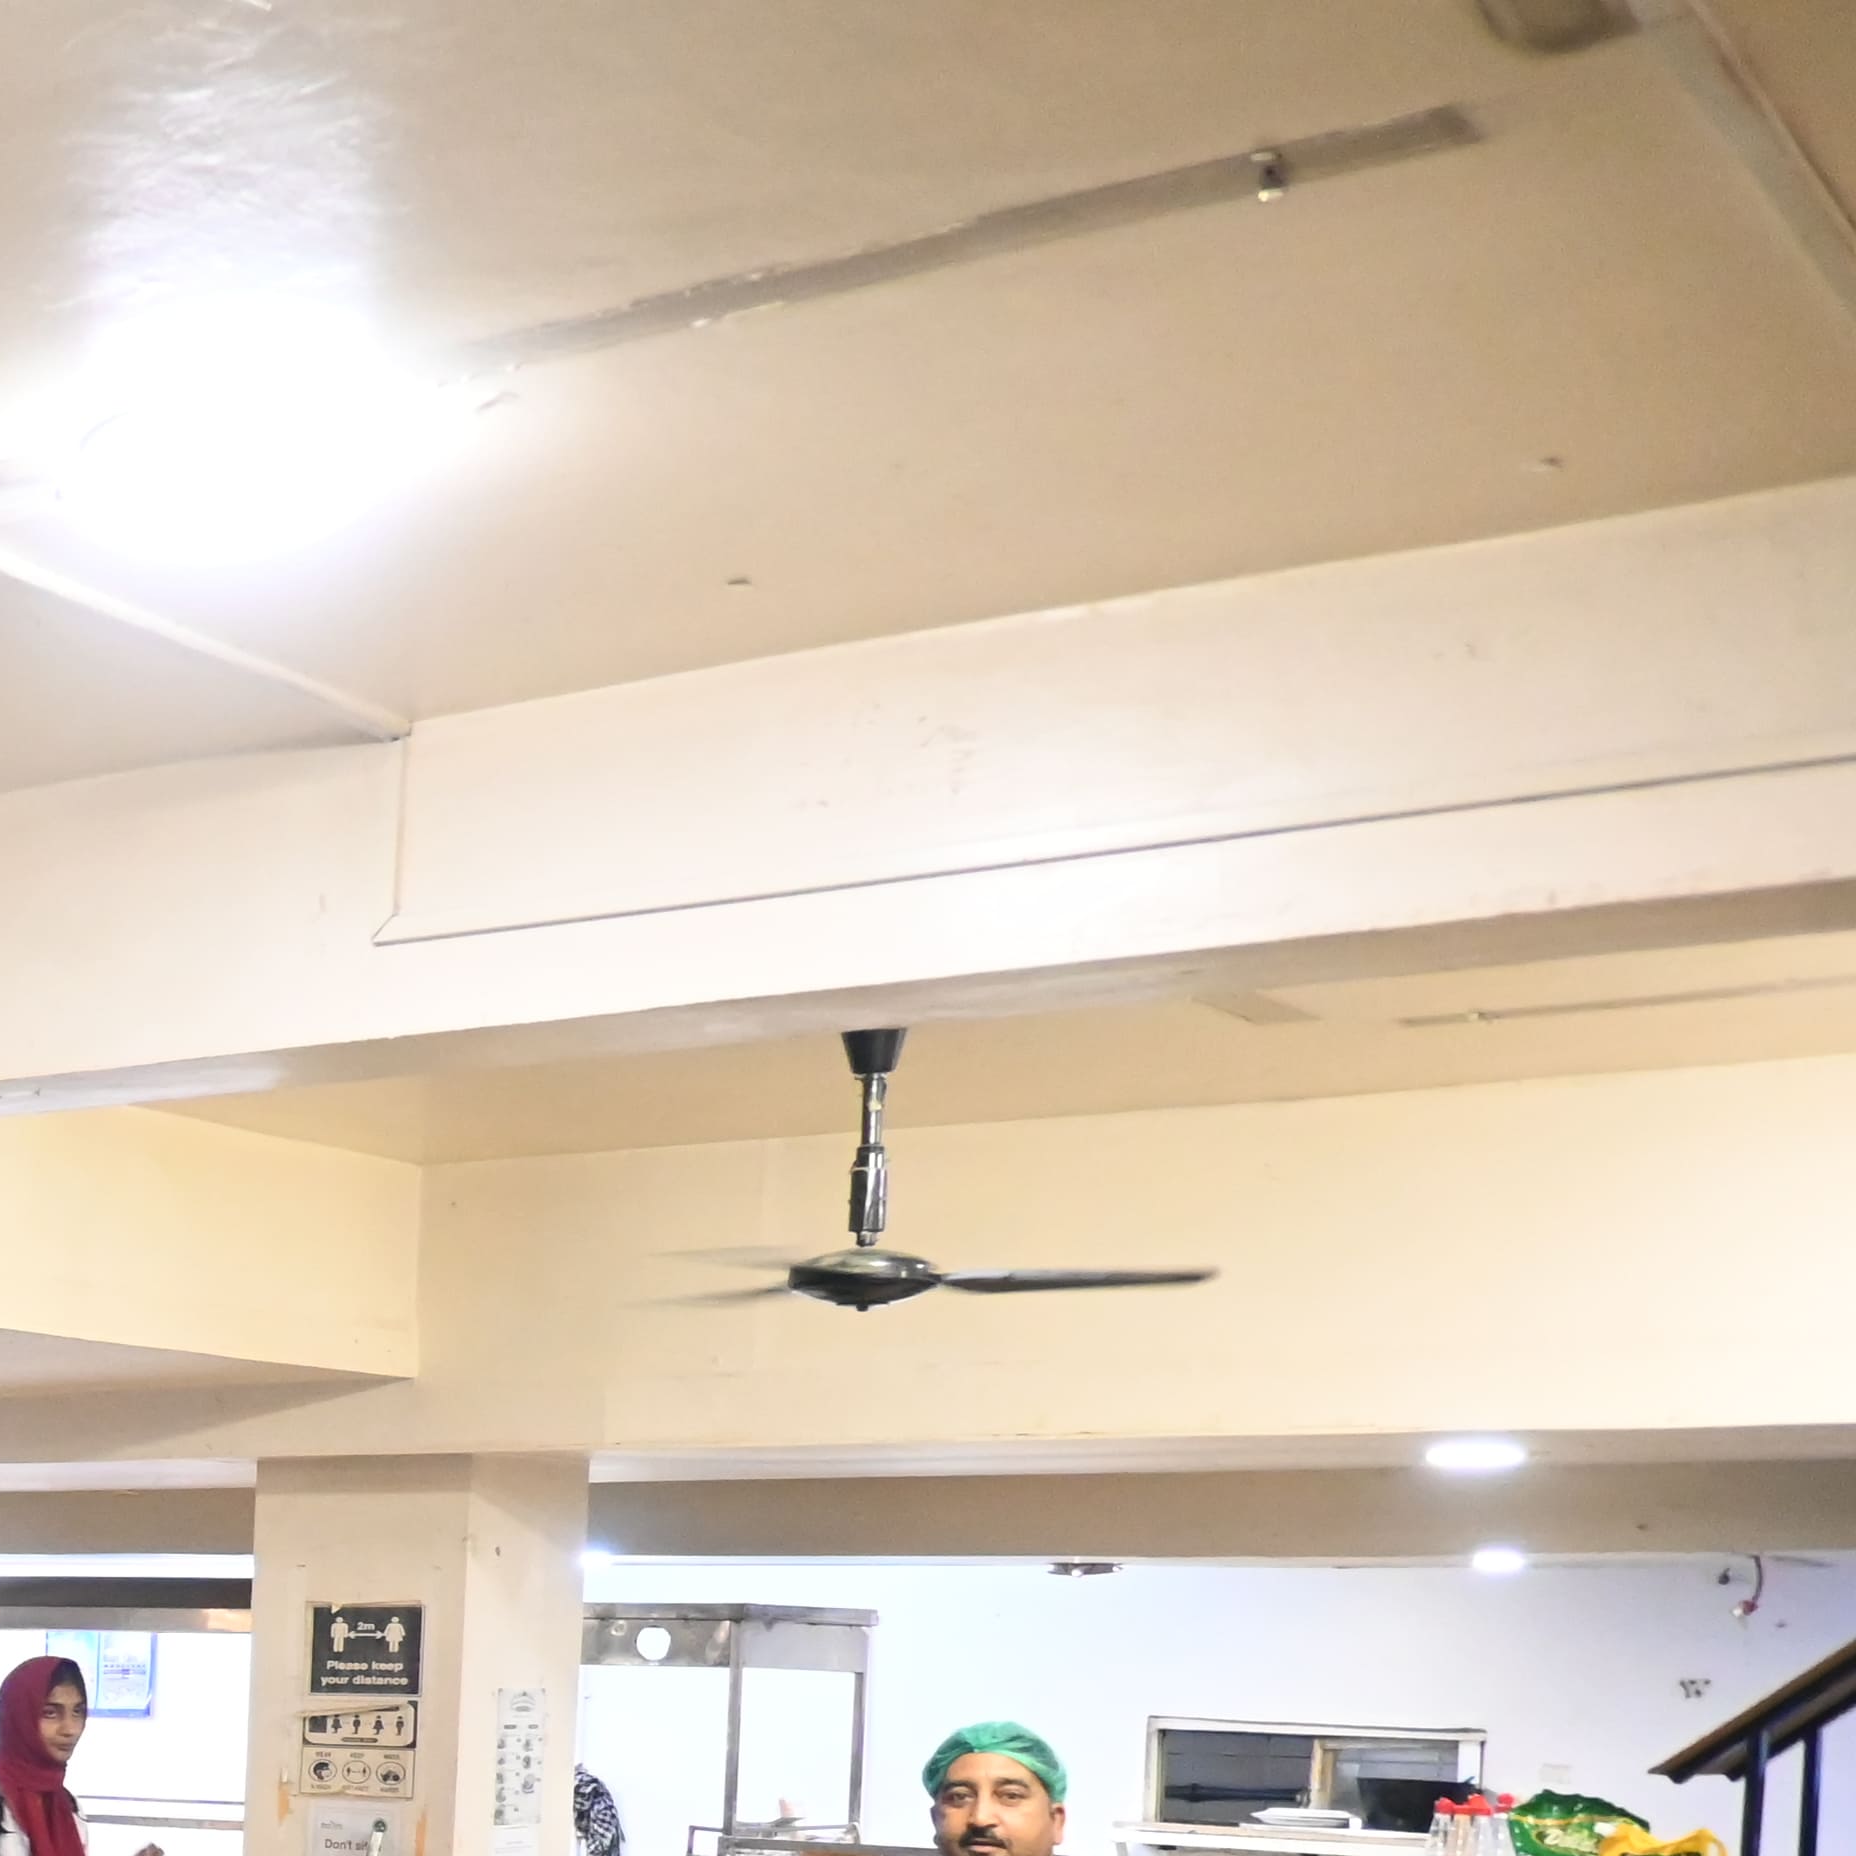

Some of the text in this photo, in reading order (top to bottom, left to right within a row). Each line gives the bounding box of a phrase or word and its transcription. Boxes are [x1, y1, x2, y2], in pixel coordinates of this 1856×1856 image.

[356, 1622, 375, 1631] 2m
[327, 1660, 403, 1673] Please keep
[320, 1675, 409, 1687] your distance
[324, 1838, 352, 1850] Don't
